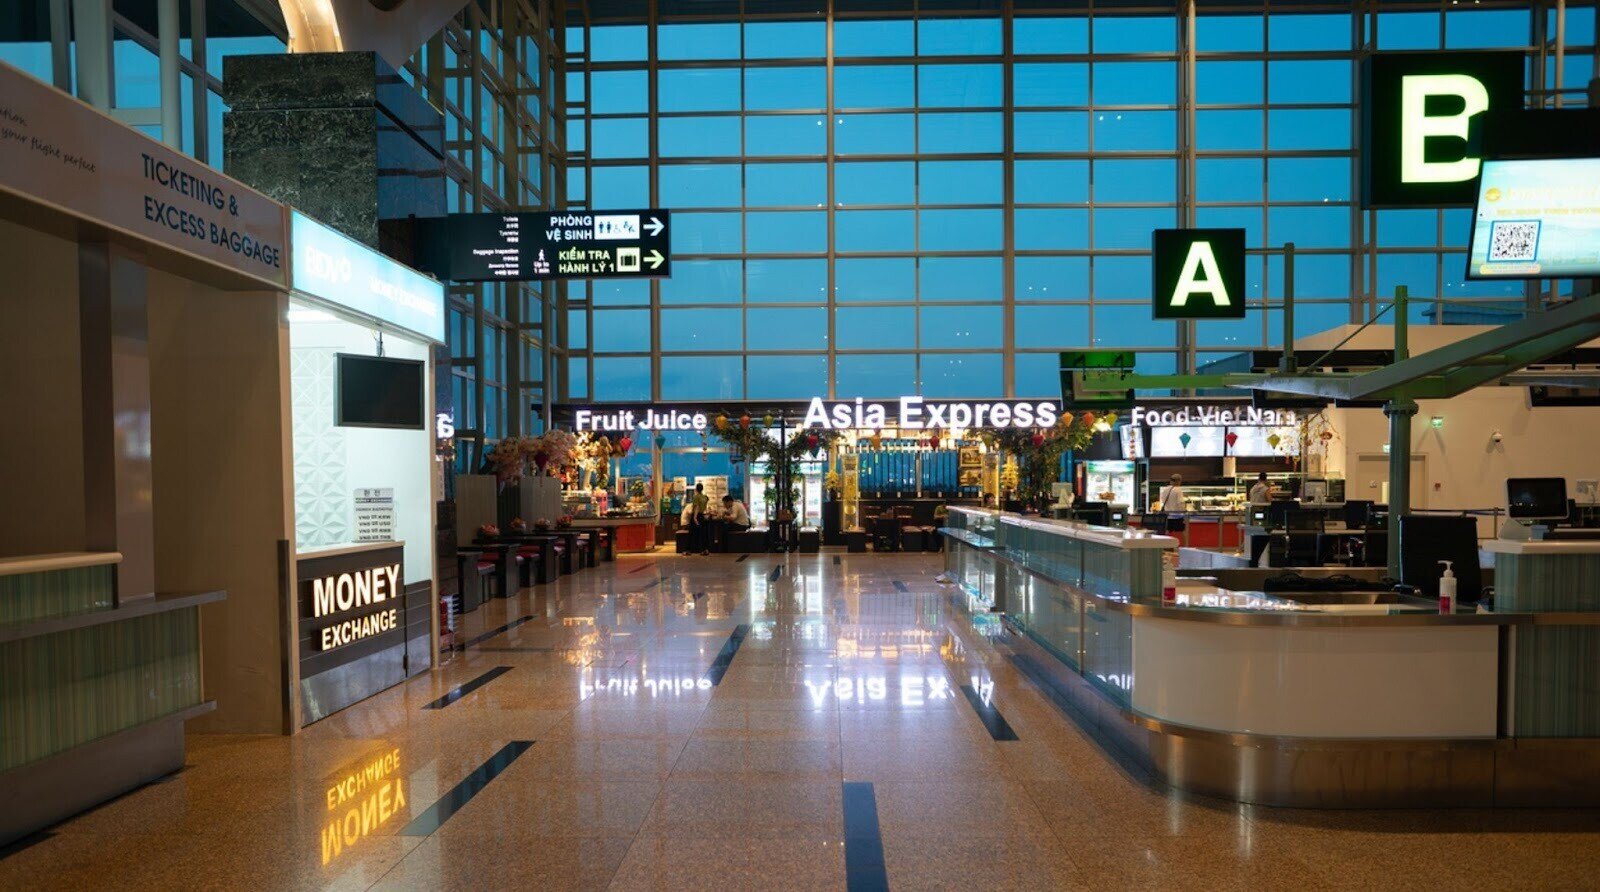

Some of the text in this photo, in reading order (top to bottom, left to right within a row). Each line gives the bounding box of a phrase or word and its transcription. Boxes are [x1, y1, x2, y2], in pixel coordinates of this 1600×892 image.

[1401, 74, 1489, 183] B
[142, 153, 239, 217] TICKETING &
[144, 196, 280, 268] EXCESS BAGGAGE
[546, 228, 593, 242] VỆ SINH
[550, 214, 593, 227] PHÒNG
[559, 246, 611, 260] KIỂM TRA
[559, 261, 590, 273] HÀNH
[609, 263, 615, 273] 1
[1169, 241, 1231, 306] A
[576, 409, 708, 431] Fruit Juice
[803, 396, 1057, 438] Asia Express
[1131, 406, 1190, 427] Food
[313, 564, 400, 618] MONEY
[321, 609, 397, 651] EXCHANGE
